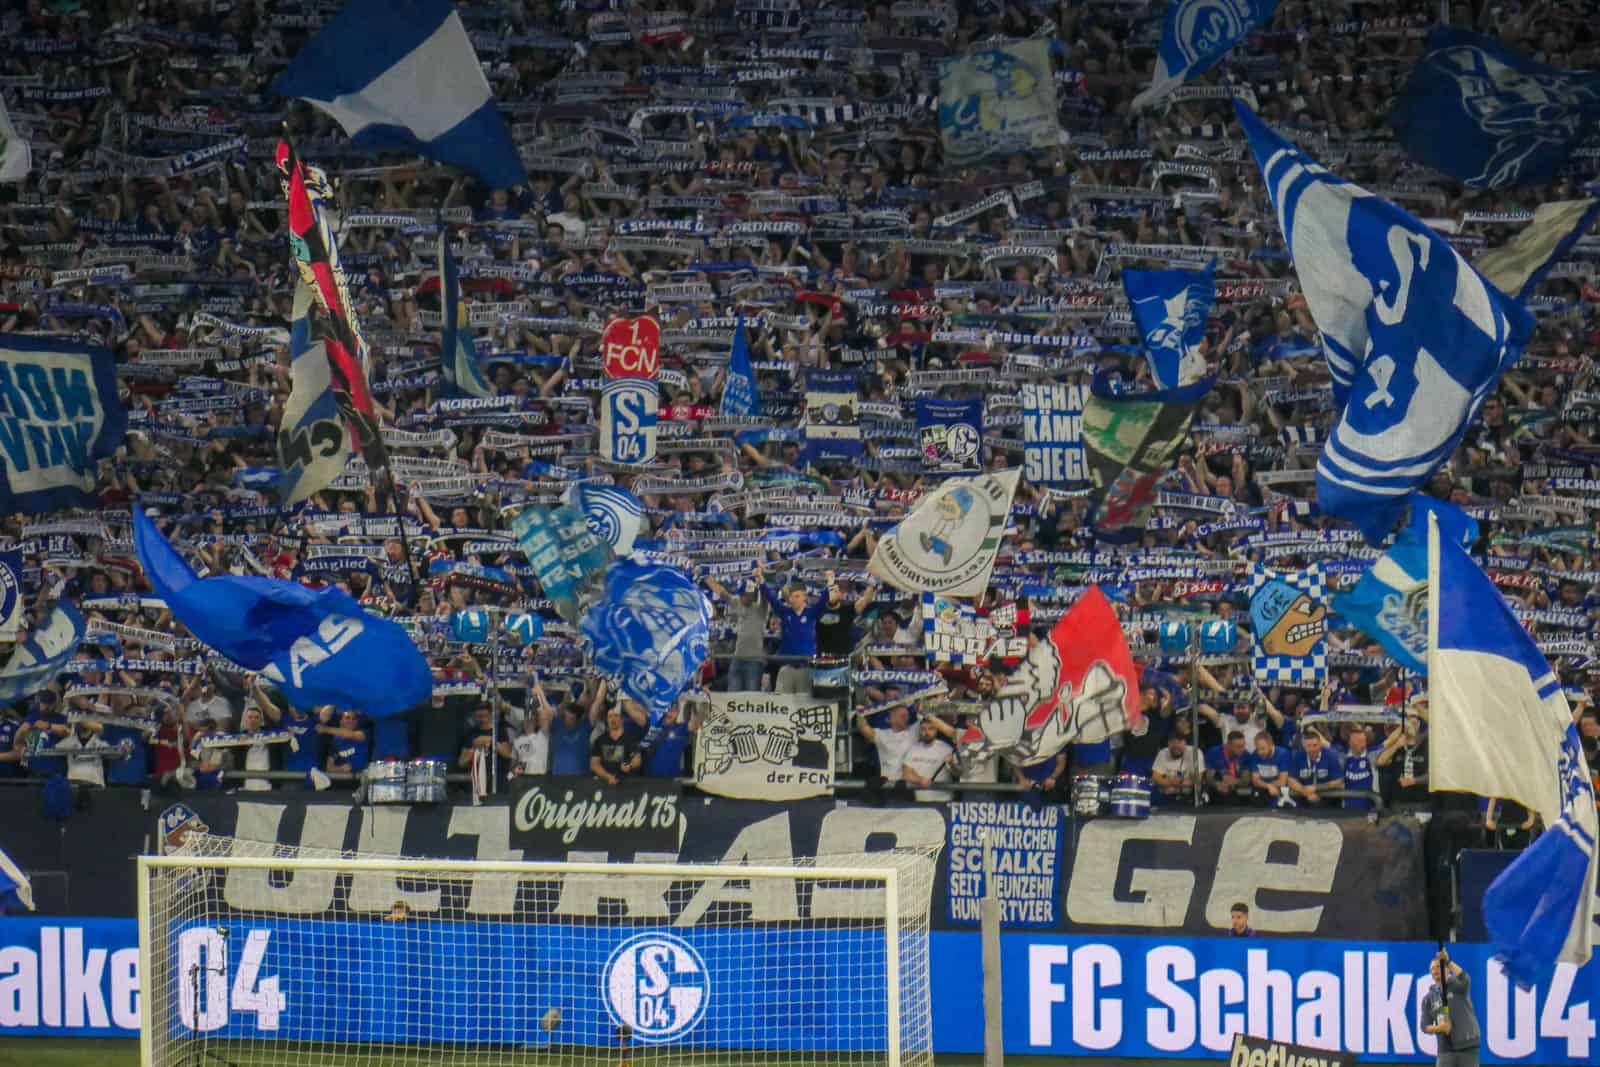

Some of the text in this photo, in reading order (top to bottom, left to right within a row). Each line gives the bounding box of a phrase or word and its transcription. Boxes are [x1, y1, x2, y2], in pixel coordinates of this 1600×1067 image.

[605, 346, 658, 374] FCN
[303, 558, 369, 573] Mitglied
[1027, 551, 1091, 565] SCHALKE
[1129, 566, 1193, 579] SCHALKE
[127, 658, 192, 672] SCHALKE
[727, 700, 790, 716] Schalke
[756, 723, 768, 736] &
[766, 770, 830, 785] der FCN
[514, 785, 678, 844] Original 75
[951, 802, 1058, 829] FUSSBALLCLUB
[951, 871, 982, 897] SEIT
[178, 925, 286, 1031] 04
[1029, 943, 1123, 1050] FC
